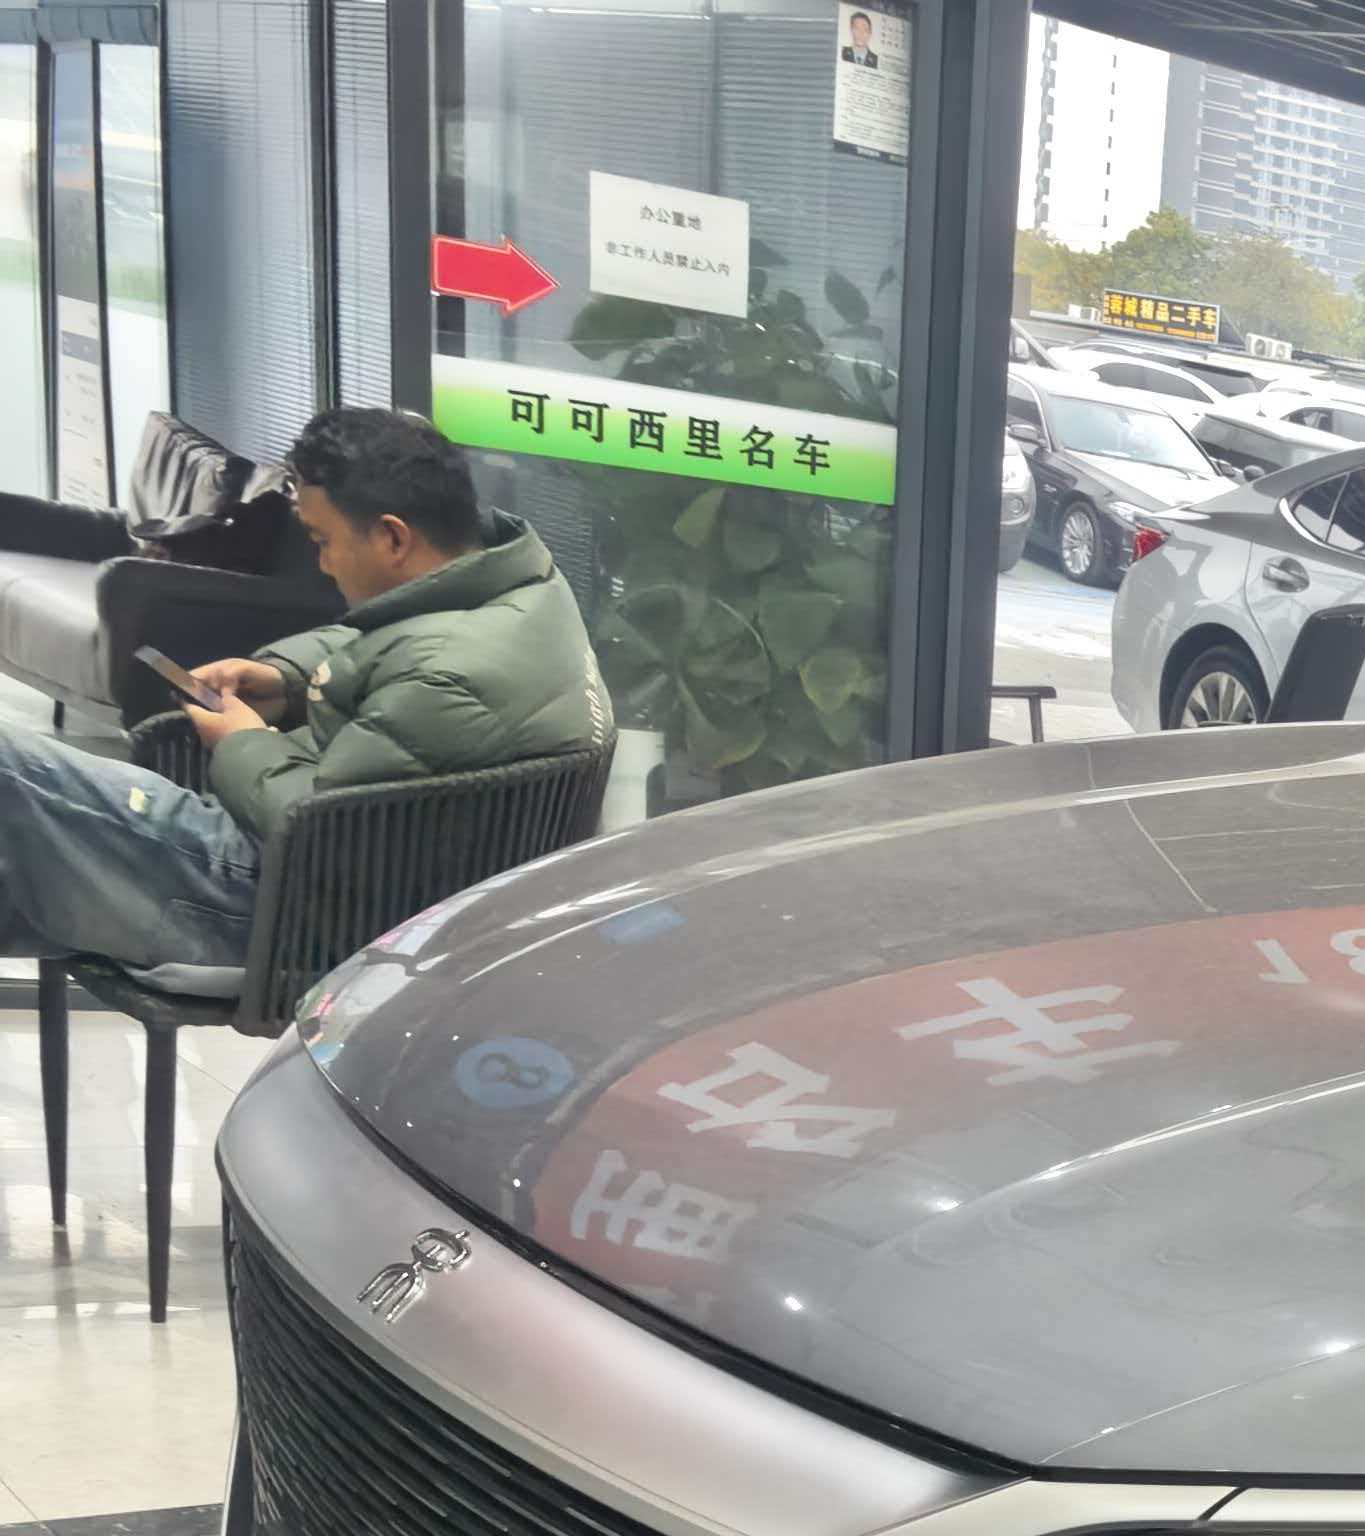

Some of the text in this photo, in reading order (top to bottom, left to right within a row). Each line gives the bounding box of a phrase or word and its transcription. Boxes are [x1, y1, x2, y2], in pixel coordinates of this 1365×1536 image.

[507, 388, 831, 476] 可可西里名车
